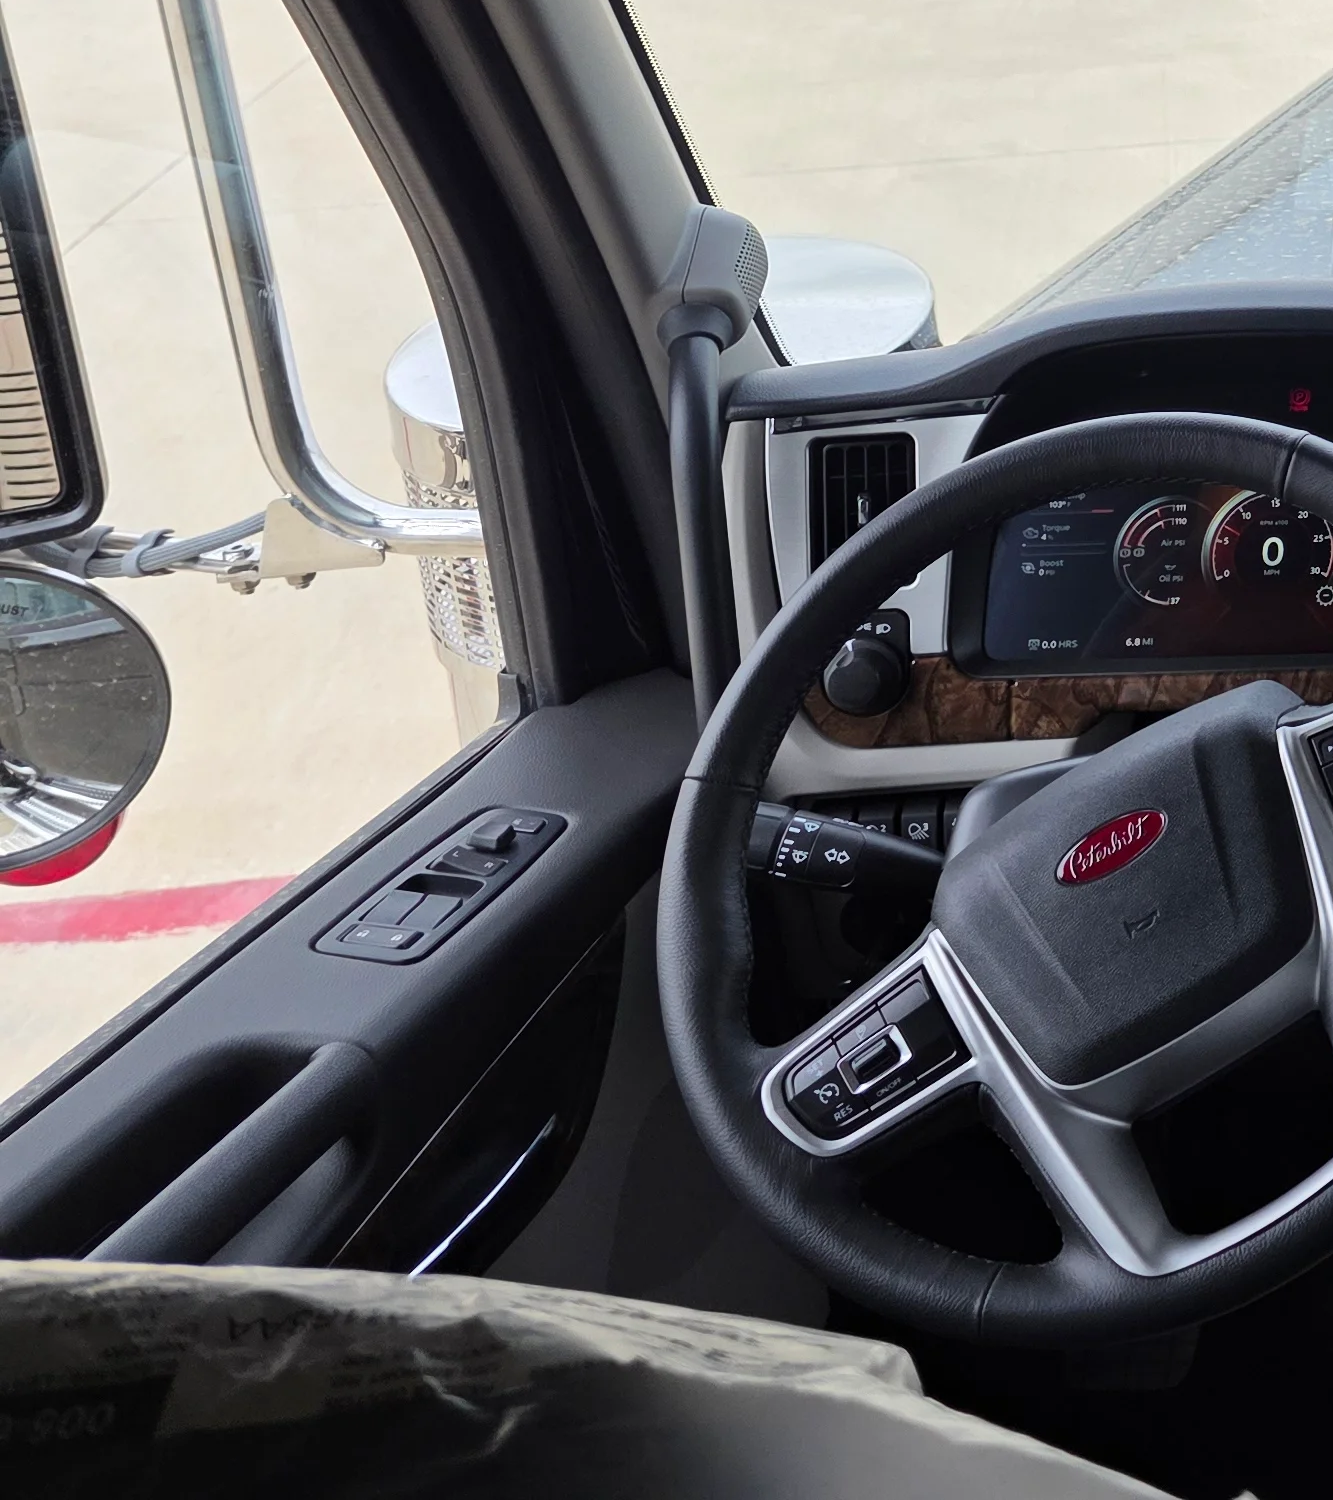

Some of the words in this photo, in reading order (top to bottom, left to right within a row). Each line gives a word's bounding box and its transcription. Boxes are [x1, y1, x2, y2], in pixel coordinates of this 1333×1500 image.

[1271, 499, 1280, 507] 15
[1241, 512, 1251, 520] 10
[1297, 511, 1308, 519] 20
[1042, 525, 1070, 533] Torque
[1262, 536, 1284, 567] 0
[1310, 567, 1320, 575] 30
[1159, 574, 1170, 582] Oil
[1041, 640, 1057, 649] 0.0
[1058, 640, 1078, 648] HRS
[1142, 638, 1153, 646] MI
[1069, 814, 1150, 879] Peterbilt
[806, 1058, 824, 1074] SET
[833, 1105, 854, 1122] RES
